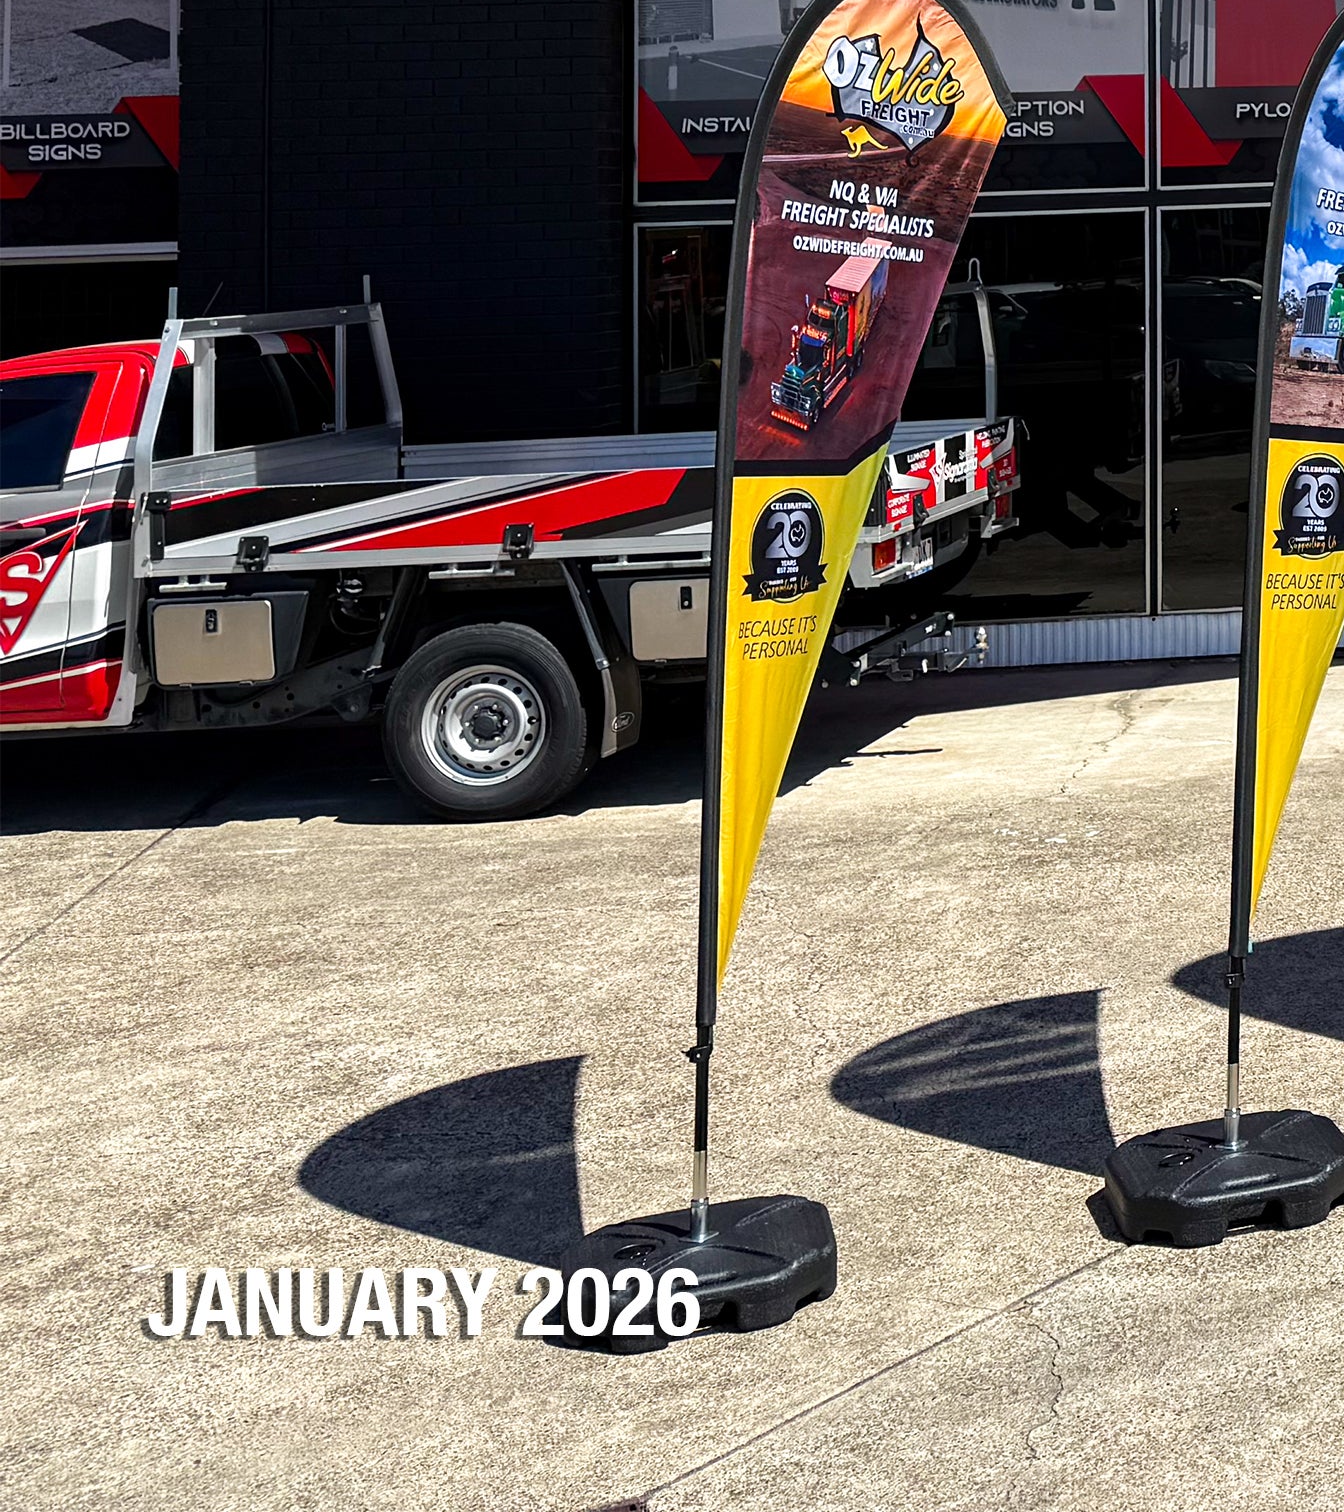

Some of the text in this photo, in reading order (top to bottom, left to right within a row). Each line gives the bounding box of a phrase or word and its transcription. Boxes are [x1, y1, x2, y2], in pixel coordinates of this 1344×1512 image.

[861, 100, 933, 127] FREIGHT
[0, 121, 131, 141] BILLBOARD
[28, 143, 102, 162] SIGNS
[829, 179, 899, 207] NQ & WA
[781, 199, 936, 238] FREIGHT SPECIALISTS
[793, 234, 925, 263] OZWIDEFREIGHT.COM.AU
[1297, 465, 1341, 475] CELEBRATING
[1292, 474, 1341, 518] 20
[765, 510, 812, 559] 20
[1265, 572, 1324, 590] BECAUSE
[1271, 593, 1337, 610] PERSONAL
[738, 615, 818, 639] BECAUSE IT'S
[742, 638, 809, 661] PERSONAL
